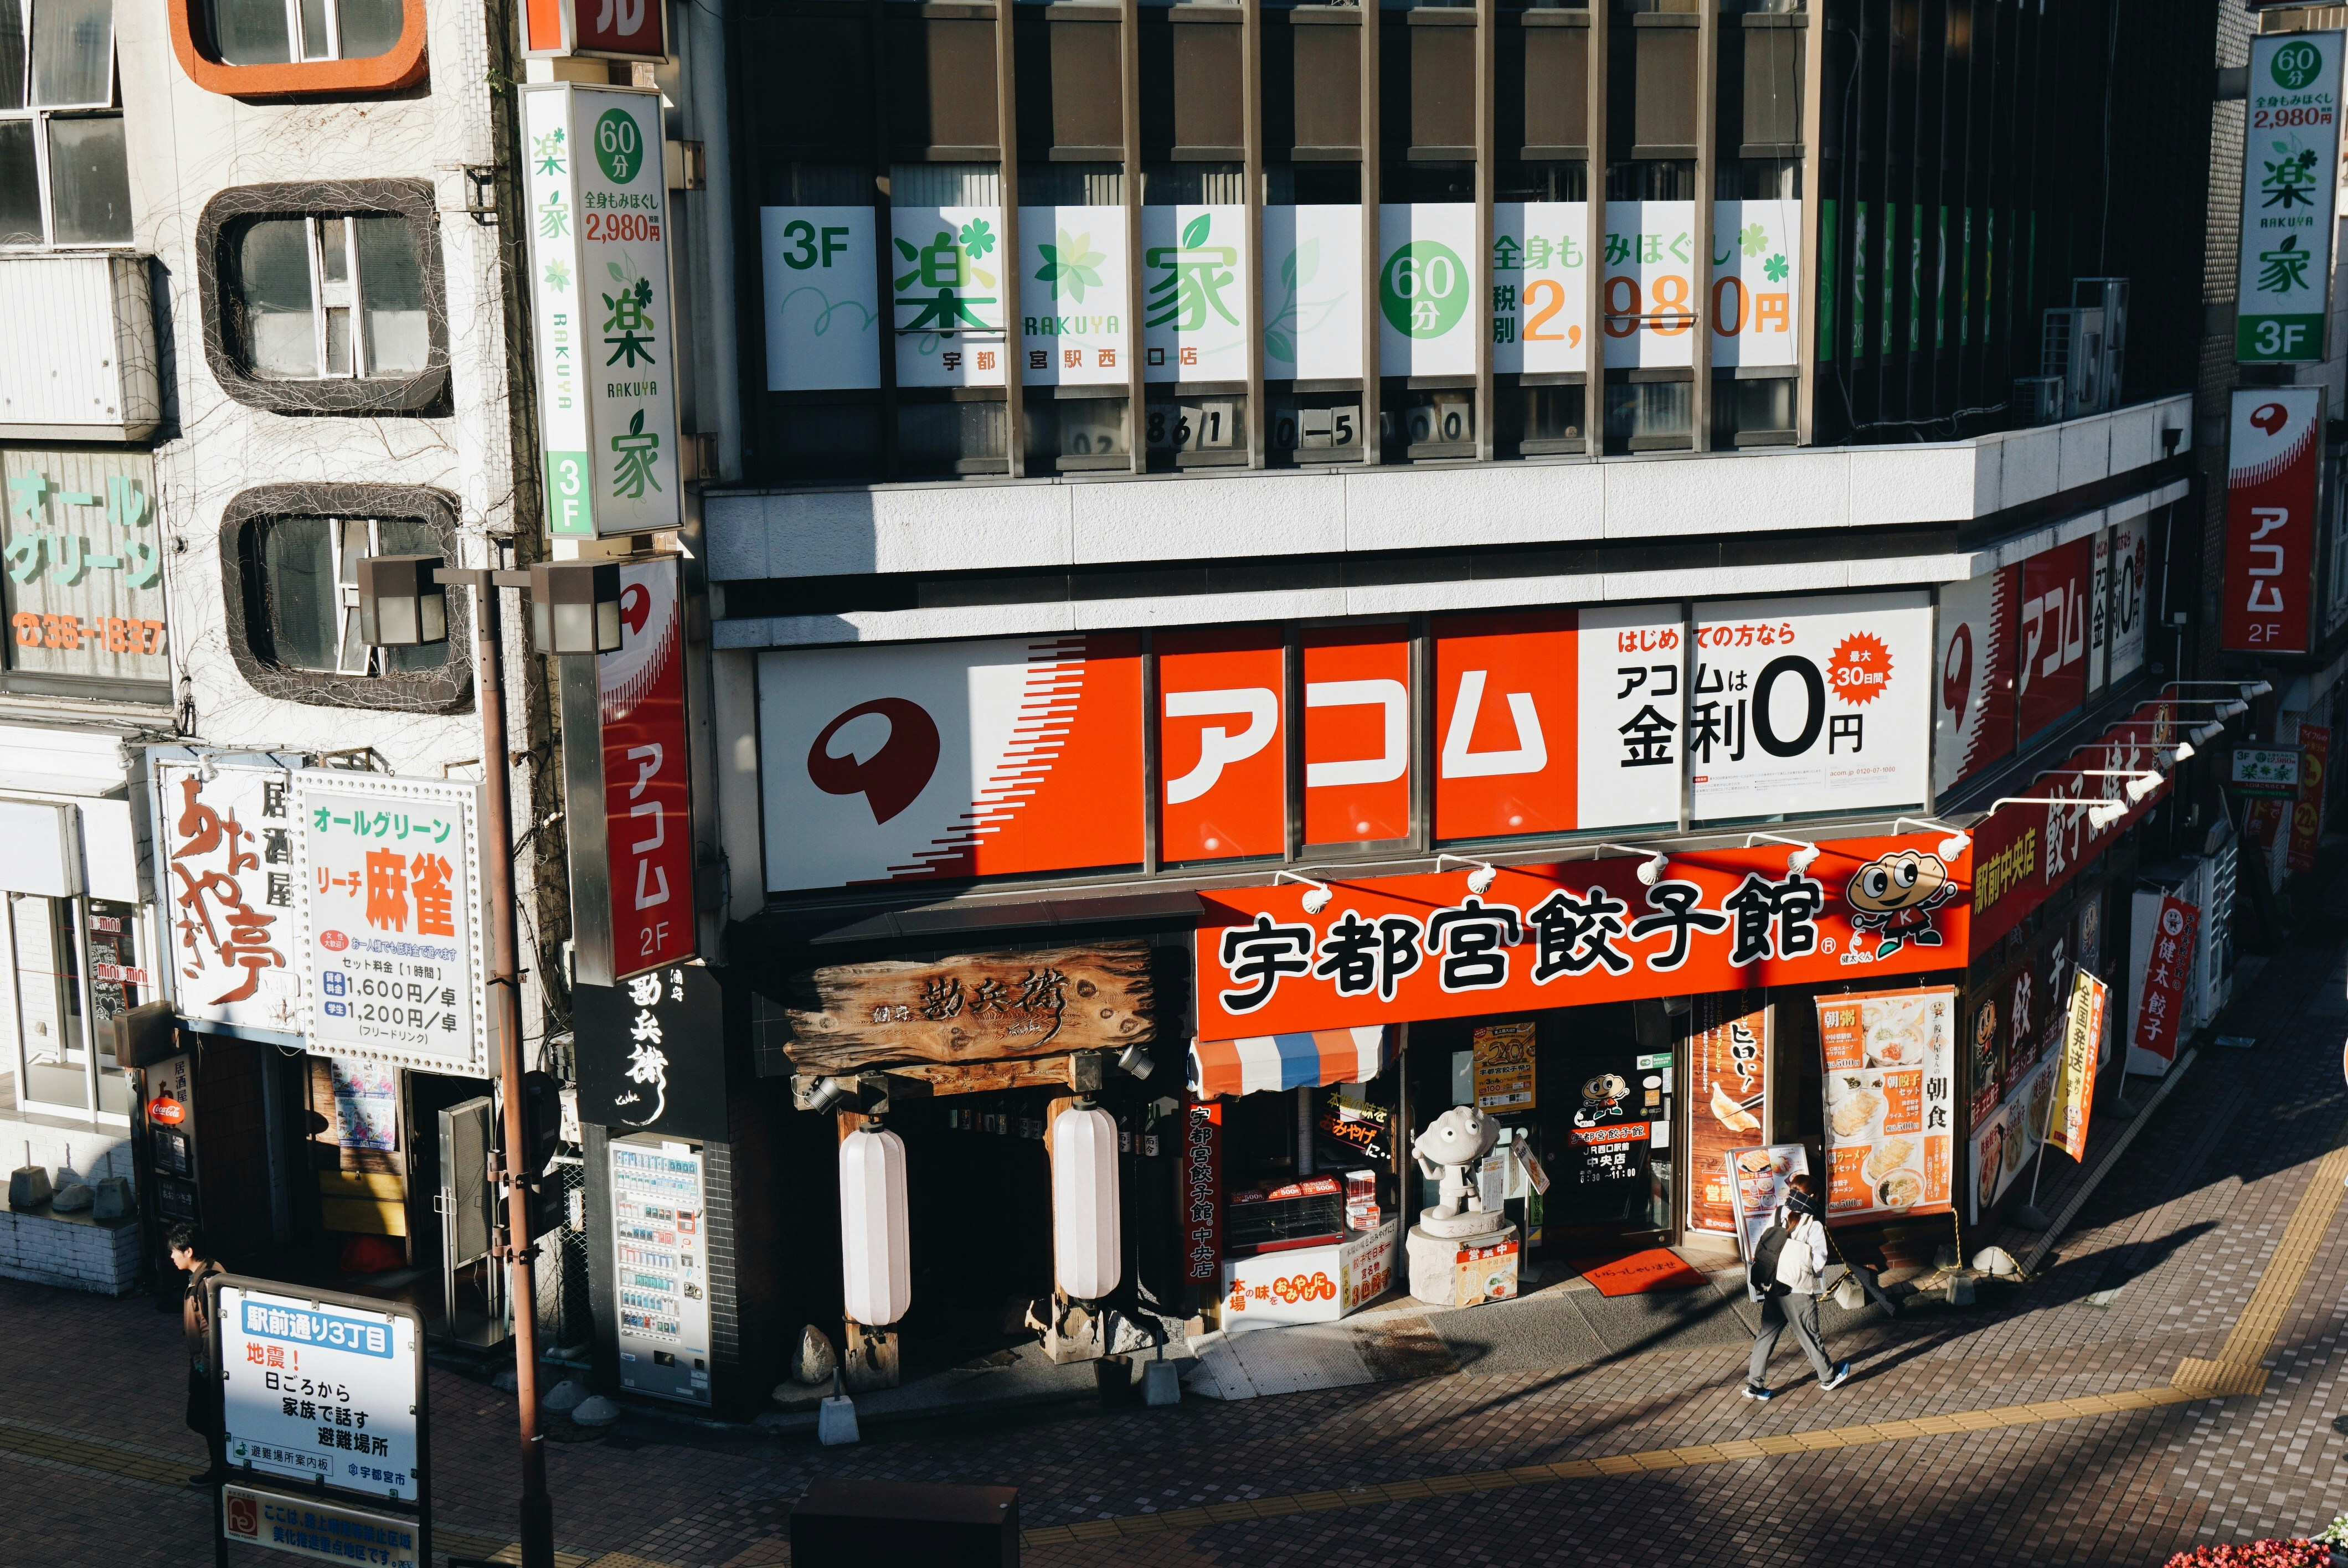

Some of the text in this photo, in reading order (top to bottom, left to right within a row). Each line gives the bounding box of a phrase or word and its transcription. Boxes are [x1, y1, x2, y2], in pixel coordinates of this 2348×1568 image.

[2278, 48, 2314, 70] 60
[2287, 70, 2304, 86] 分
[2255, 93, 2334, 108] 全身もみほぐし
[2254, 107, 2331, 131] 2,980円
[600, 120, 635, 154] 60
[611, 154, 629, 178] 分
[2262, 148, 2318, 209] 楽
[584, 191, 659, 210] 全身もみほぐし
[586, 213, 661, 244] 2,980円
[2261, 216, 2314, 229] RAKUYA
[782, 220, 849, 270] 3F
[1493, 231, 1731, 271] 全身もみほぐし
[893, 218, 997, 339] 楽
[1145, 213, 1240, 332] 家
[1391, 256, 1455, 299] 60
[2257, 235, 2311, 293] 家
[602, 277, 656, 368] 楽
[1025, 315, 1119, 336] RAKUYA
[1410, 300, 1441, 331] 分
[1522, 274, 1789, 349] 2,980円
[2254, 320, 2306, 355] 3F
[554, 313, 572, 409] RAKUYA
[607, 381, 657, 399] RAKUYA
[611, 409, 663, 499] 家
[9, 469, 143, 526] オール
[559, 459, 580, 527] 3F
[6, 529, 158, 589] グリーン
[2247, 507, 2289, 612] アコム
[43, 613, 163, 656] 36-1837
[1618, 622, 1796, 653] はじめての方なら
[2020, 577, 2084, 697] アコム
[2248, 623, 2280, 642] 2F
[1849, 649, 1872, 663] 最大
[1617, 662, 1748, 700] アコムは
[1836, 666, 1883, 687] 30日間
[1165, 669, 1548, 805] アコム
[1856, 766, 1896, 775] 0120-07-1000
[2236, 751, 2251, 761] 3F
[313, 806, 452, 844] オールグリーン
[627, 742, 671, 911] アコム
[262, 781, 295, 909] 居酒屋
[1974, 827, 2036, 915] 駅前中央店
[317, 847, 455, 938] リーチ 麻雀
[100, 916, 121, 932] mini
[1899, 908, 1912, 925] K
[351, 937, 457, 962] お一人様でも低料金で遊べます
[640, 921, 670, 957] 2F
[1218, 871, 1824, 1016] 宇都宮餃子館
[97, 962, 148, 984] mini mini
[1841, 953, 1872, 964] 健太くん
[326, 983, 343, 994] 料金
[2144, 936, 2176, 1041] 健太餃子
[327, 1003, 344, 1014] 学生
[1824, 1010, 1856, 1029] 朝粥
[2068, 984, 2090, 1073] 全国発送
[2088, 992, 2102, 1066] 健太餃子
[1933, 1024, 1942, 1075] 餃子屋さんの
[174, 1060, 188, 1103] 居酒屋
[1479, 1064, 1531, 1076] 宇都宮餃子祭り
[1886, 1073, 1921, 1089] 朝餃子
[1327, 1091, 1388, 1123] 本場の味を
[1898, 1087, 1920, 1097] セット
[1926, 1077, 1948, 1130] 朝食
[1320, 1114, 1377, 1145] おみやげ
[1571, 1126, 1645, 1144] 宇都宮餃子館
[1583, 1142, 1630, 1156] JR西口駅前
[1587, 1153, 1626, 1168] 中央店
[1188, 1106, 1215, 1279] 宇都宮餃子館 中央店
[1460, 1166, 1474, 1187] K
[1468, 1244, 1508, 1261] 営業中
[1594, 1260, 1676, 1279] いらっしゃいませ
[1352, 1266, 1392, 1307] 3色餃子
[246, 1305, 386, 1354] 駅前通り3丁目
[265, 1371, 351, 1402] 日ごろから
[282, 1397, 369, 1430] 家族で話す
[250, 1445, 328, 1471] 避難場所案内板
[317, 1426, 389, 1458] 避難場所
[360, 1466, 406, 1486] 宇都宮市
